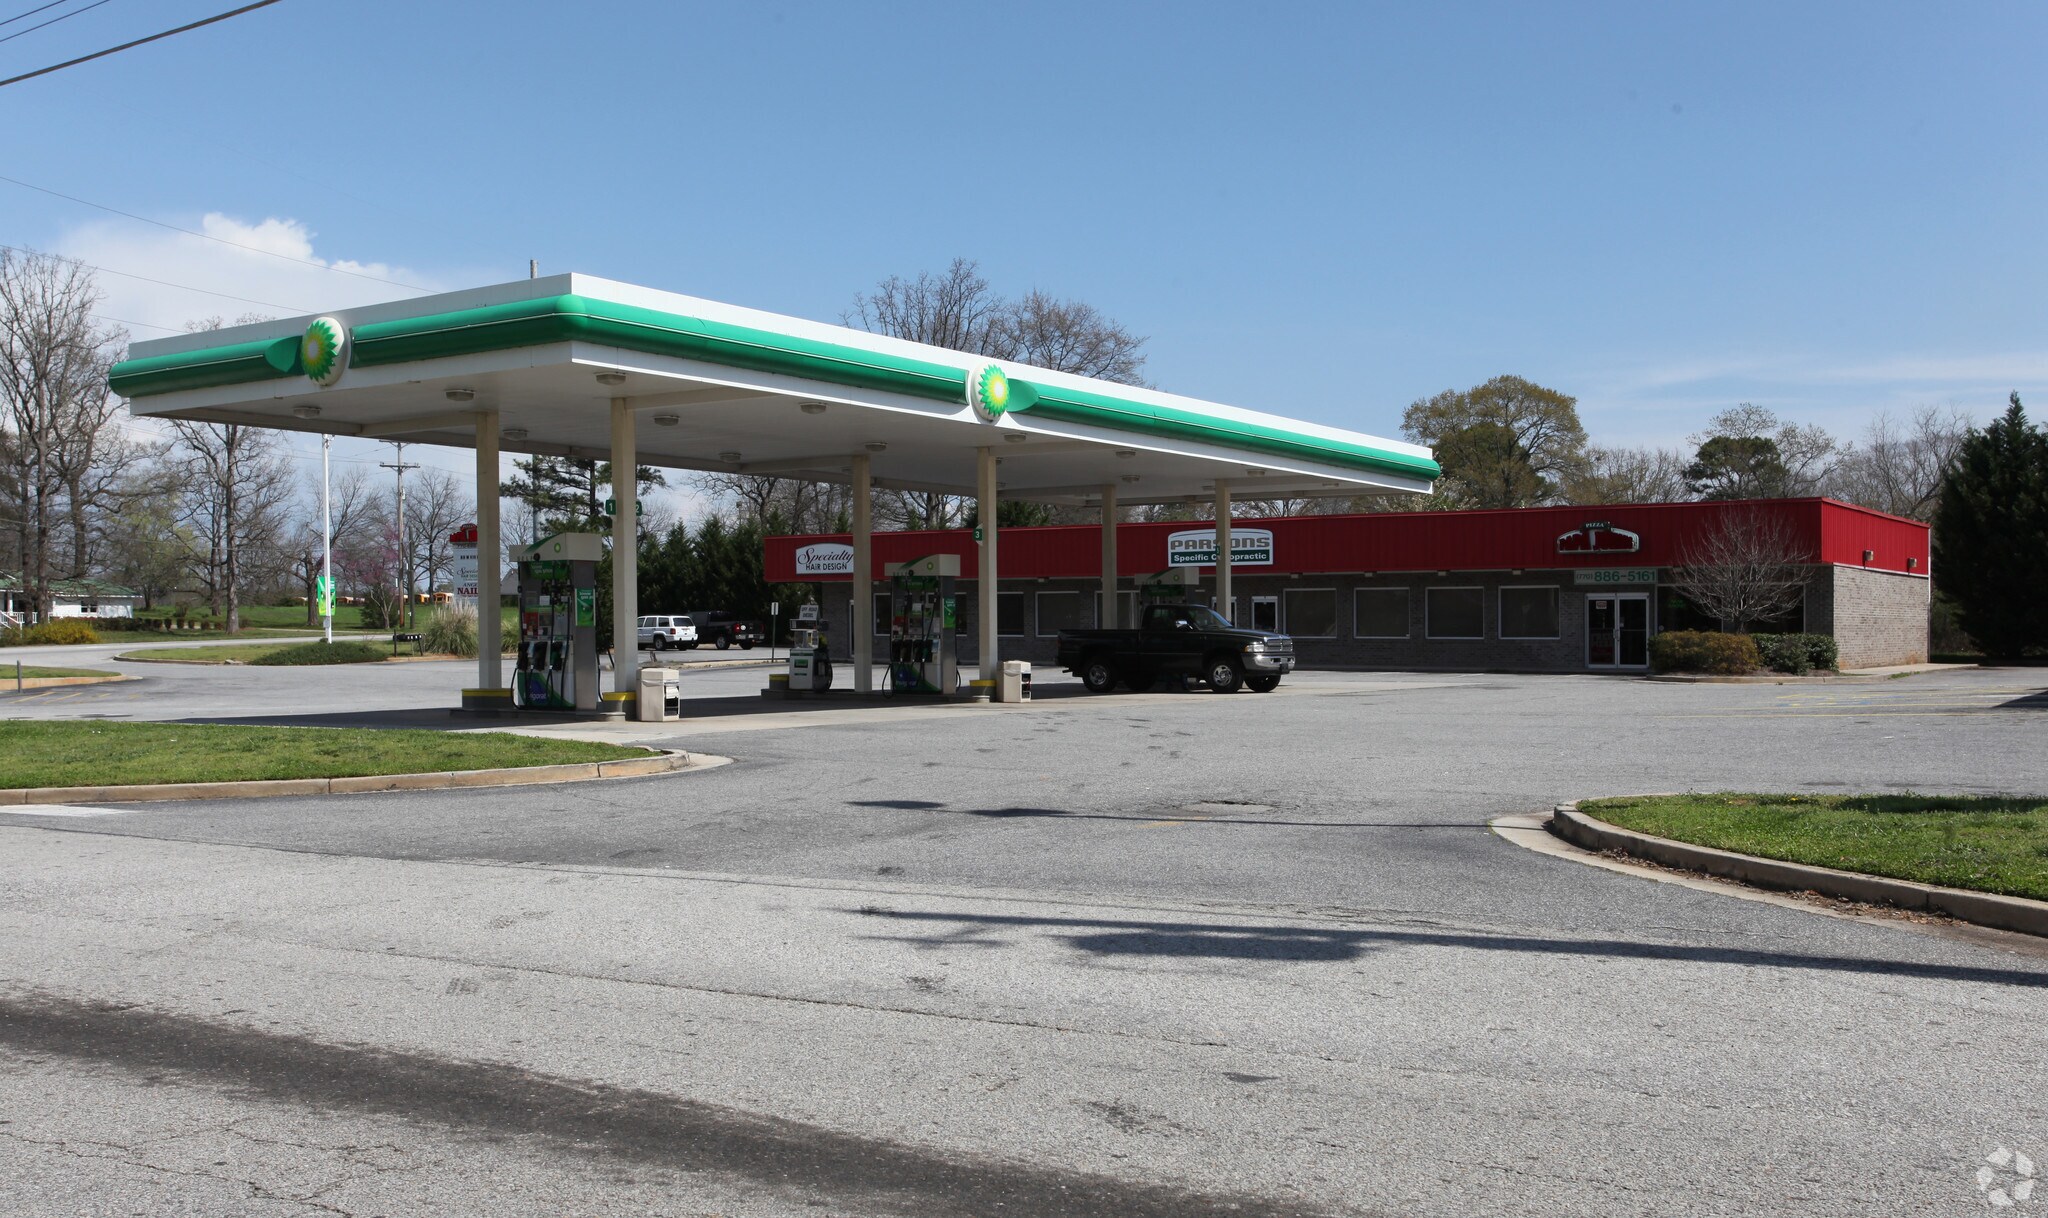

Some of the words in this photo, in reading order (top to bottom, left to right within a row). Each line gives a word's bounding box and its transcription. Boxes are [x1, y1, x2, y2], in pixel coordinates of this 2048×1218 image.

[975, 530, 980, 539] 3
[797, 547, 854, 565] Specialty
[1174, 553, 1209, 563] Specific
[1211, 552, 1267, 562] Copractic
[805, 563, 821, 571] HAIR
[822, 562, 847, 571] DESIGN
[1594, 570, 1656, 582] 886-5161
[457, 587, 478, 595] NAIL
